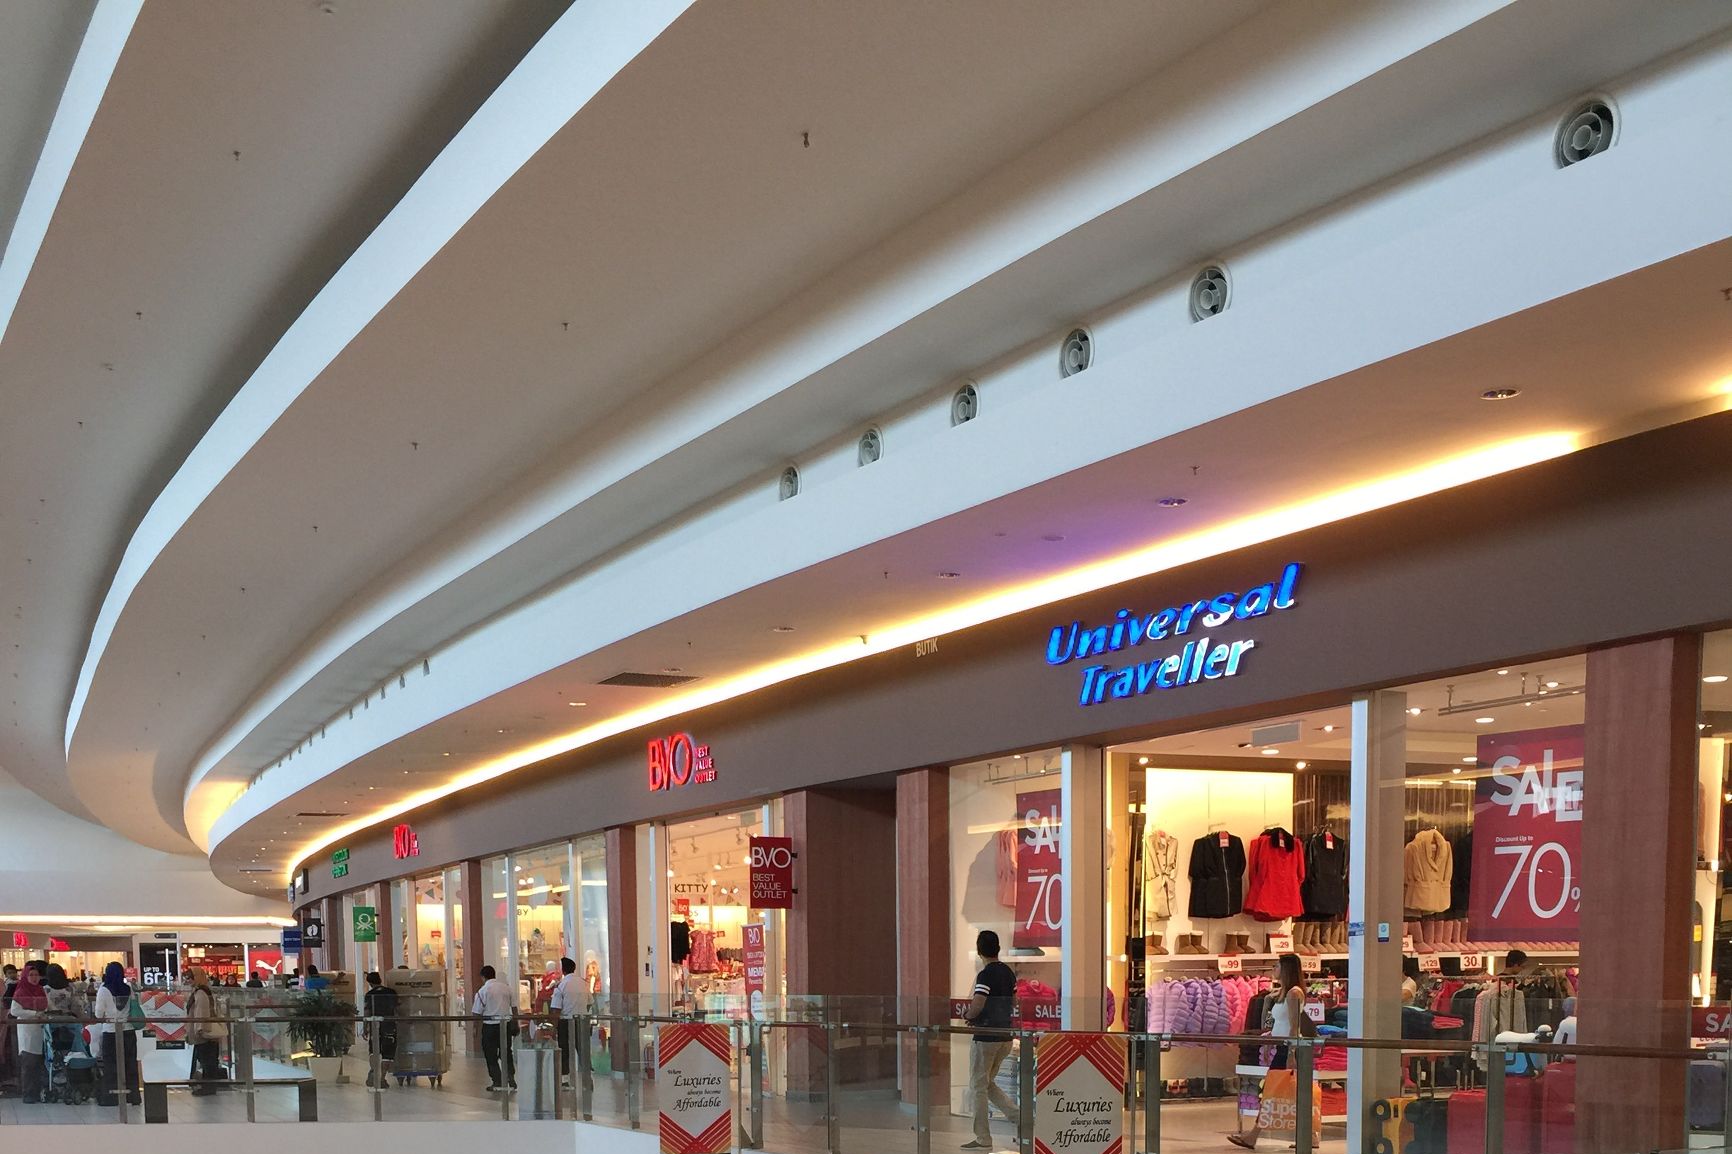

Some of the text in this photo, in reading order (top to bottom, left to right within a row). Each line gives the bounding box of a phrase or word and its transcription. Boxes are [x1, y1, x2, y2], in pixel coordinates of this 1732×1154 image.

[1045, 562, 1305, 665] Universal
[916, 637, 938, 658] BUTIK
[1079, 637, 1255, 707] Traveller
[647, 731, 693, 792] BVO
[1490, 748, 1583, 823] SALE
[751, 846, 792, 868] BVO
[752, 873, 776, 882] BEST
[674, 883, 708, 893] KITTY
[752, 882, 782, 891] VALUE
[752, 890, 788, 899] OUTLET
[1463, 956, 1478, 967] 30
[674, 1073, 722, 1088] Luxuries
[1046, 1088, 1065, 1097] Where
[673, 1096, 722, 1111] Affordable
[1053, 1097, 1113, 1116] Luxuries
[1261, 1098, 1297, 1116] Supe
[1070, 1117, 1112, 1127] always become
[1258, 1113, 1296, 1129] Store
[1051, 1127, 1111, 1148] Affordable
